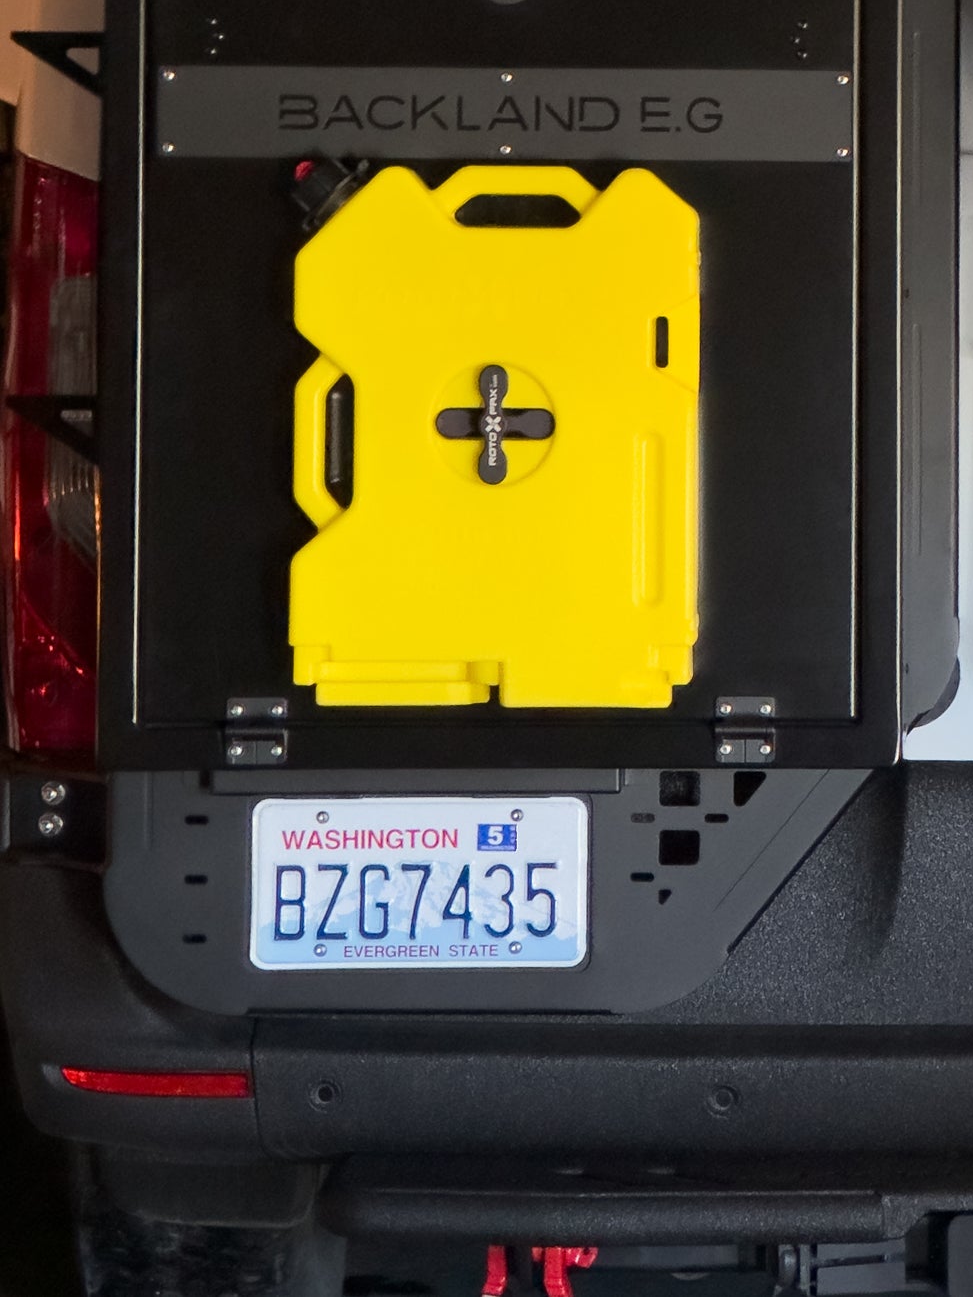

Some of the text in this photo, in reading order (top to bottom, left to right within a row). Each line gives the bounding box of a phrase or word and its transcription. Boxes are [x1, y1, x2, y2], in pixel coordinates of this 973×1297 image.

[278, 94, 724, 134] BACKLAND E.G
[281, 828, 459, 850] WASHINGTON
[487, 825, 504, 846] 5
[274, 862, 558, 941] BZG7435
[343, 944, 499, 958] EVERGREEN STATE
